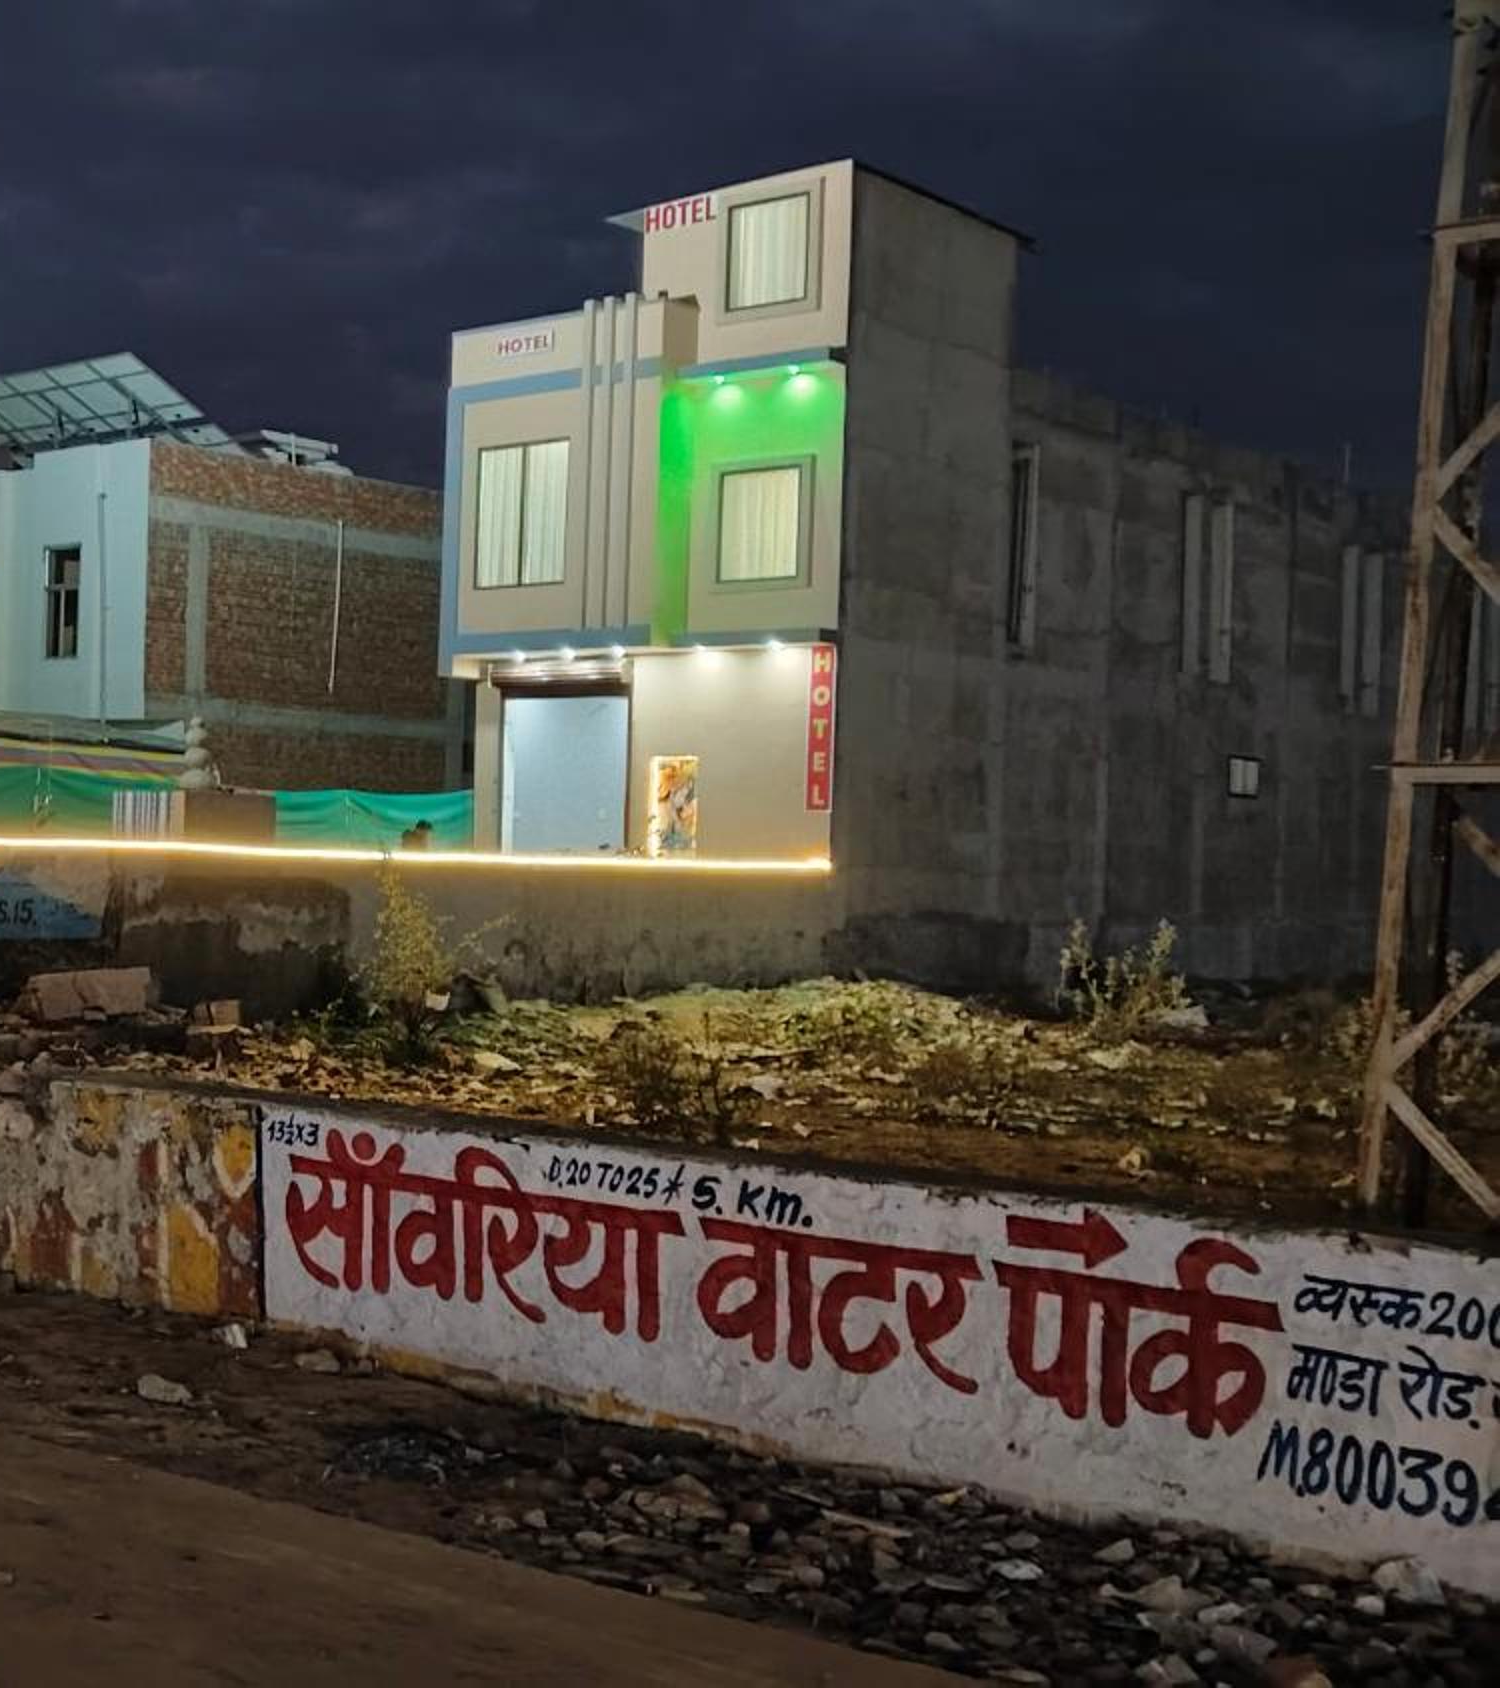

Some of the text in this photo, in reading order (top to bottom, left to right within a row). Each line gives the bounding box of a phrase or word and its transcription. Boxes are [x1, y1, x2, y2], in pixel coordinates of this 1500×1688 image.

[645, 195, 717, 234] HOTEL
[498, 335, 548, 354] HOTEL
[812, 651, 832, 806] HOTEL
[697, 1216, 984, 1394] वाटर
[993, 1237, 1285, 1439] पार्क
